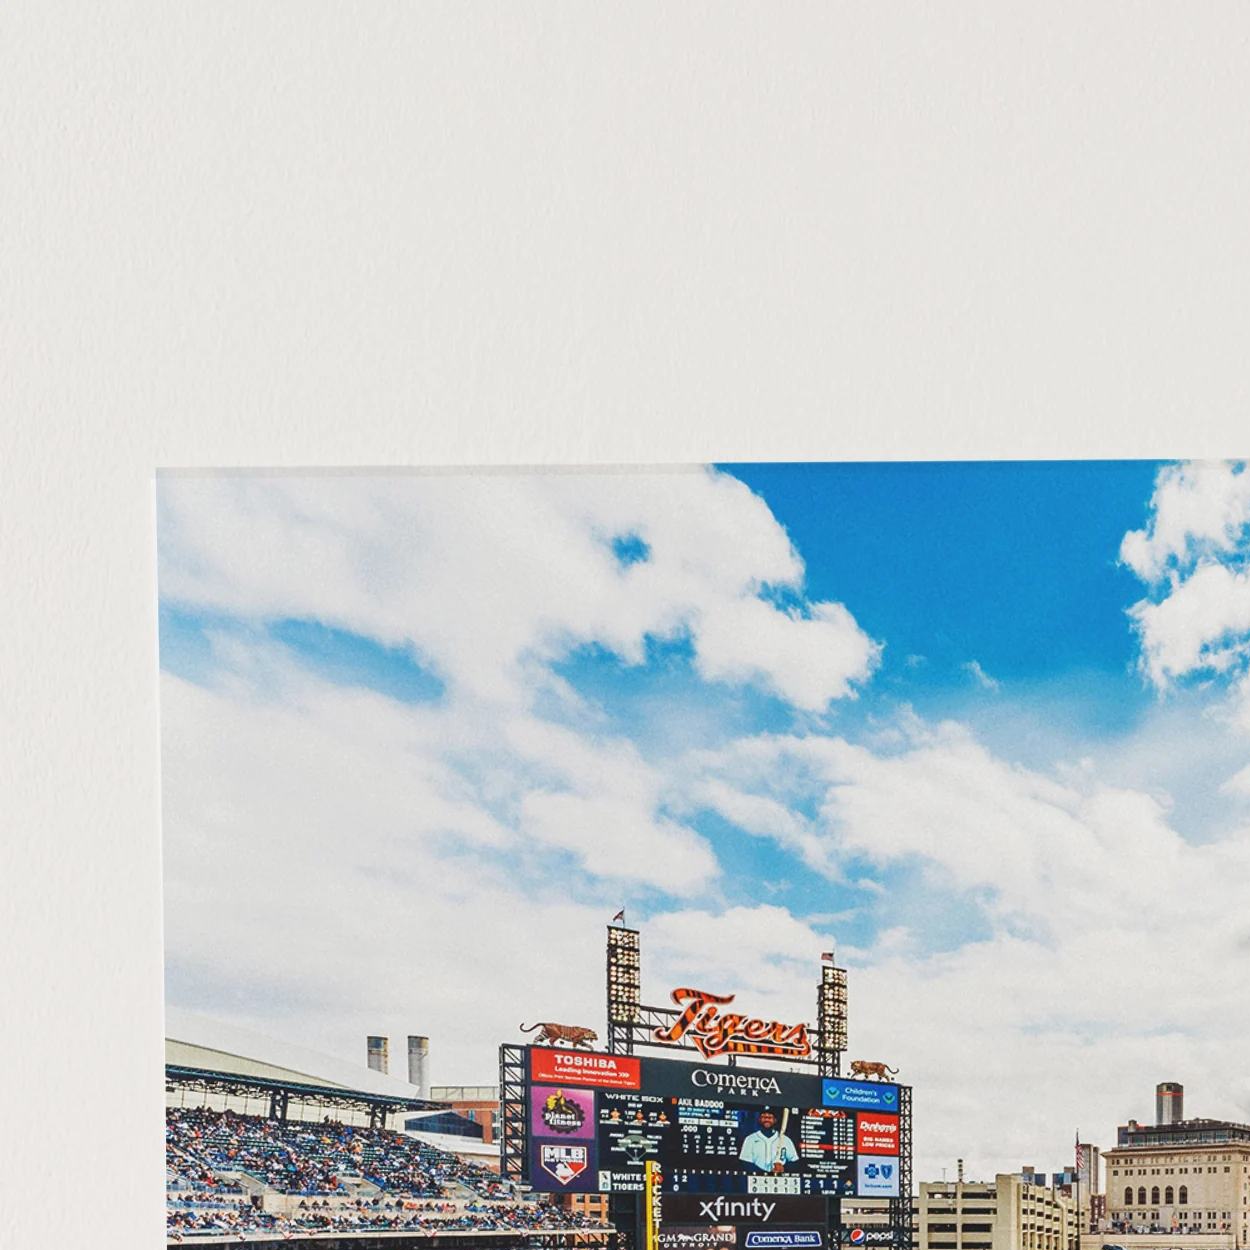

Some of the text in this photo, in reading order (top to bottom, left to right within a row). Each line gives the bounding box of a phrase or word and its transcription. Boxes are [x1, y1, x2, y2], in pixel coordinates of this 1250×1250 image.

[653, 988, 812, 1060] Tigers
[554, 1054, 617, 1070] TOSHIBA
[554, 1065, 618, 1077] Leading Innovation
[717, 1087, 759, 1097] PARK
[844, 1087, 877, 1097] Children's
[605, 1093, 640, 1102] WHITE
[841, 1094, 881, 1104] Foundation
[694, 1099, 724, 1109] BADDOO
[544, 1110, 576, 1121] planet
[549, 1117, 582, 1127] fitness
[544, 1146, 584, 1159] MLB
[612, 1173, 642, 1182] WHITE
[682, 1175, 688, 1183] 2
[612, 1182, 645, 1191] TIGERS
[673, 1184, 680, 1192] 0
[804, 1179, 838, 1189] 2 1 1
[699, 1195, 776, 1221] xfinity
[693, 1232, 734, 1242] GRAND
[794, 1233, 816, 1243] Bank
[866, 1230, 894, 1242] pepsi
